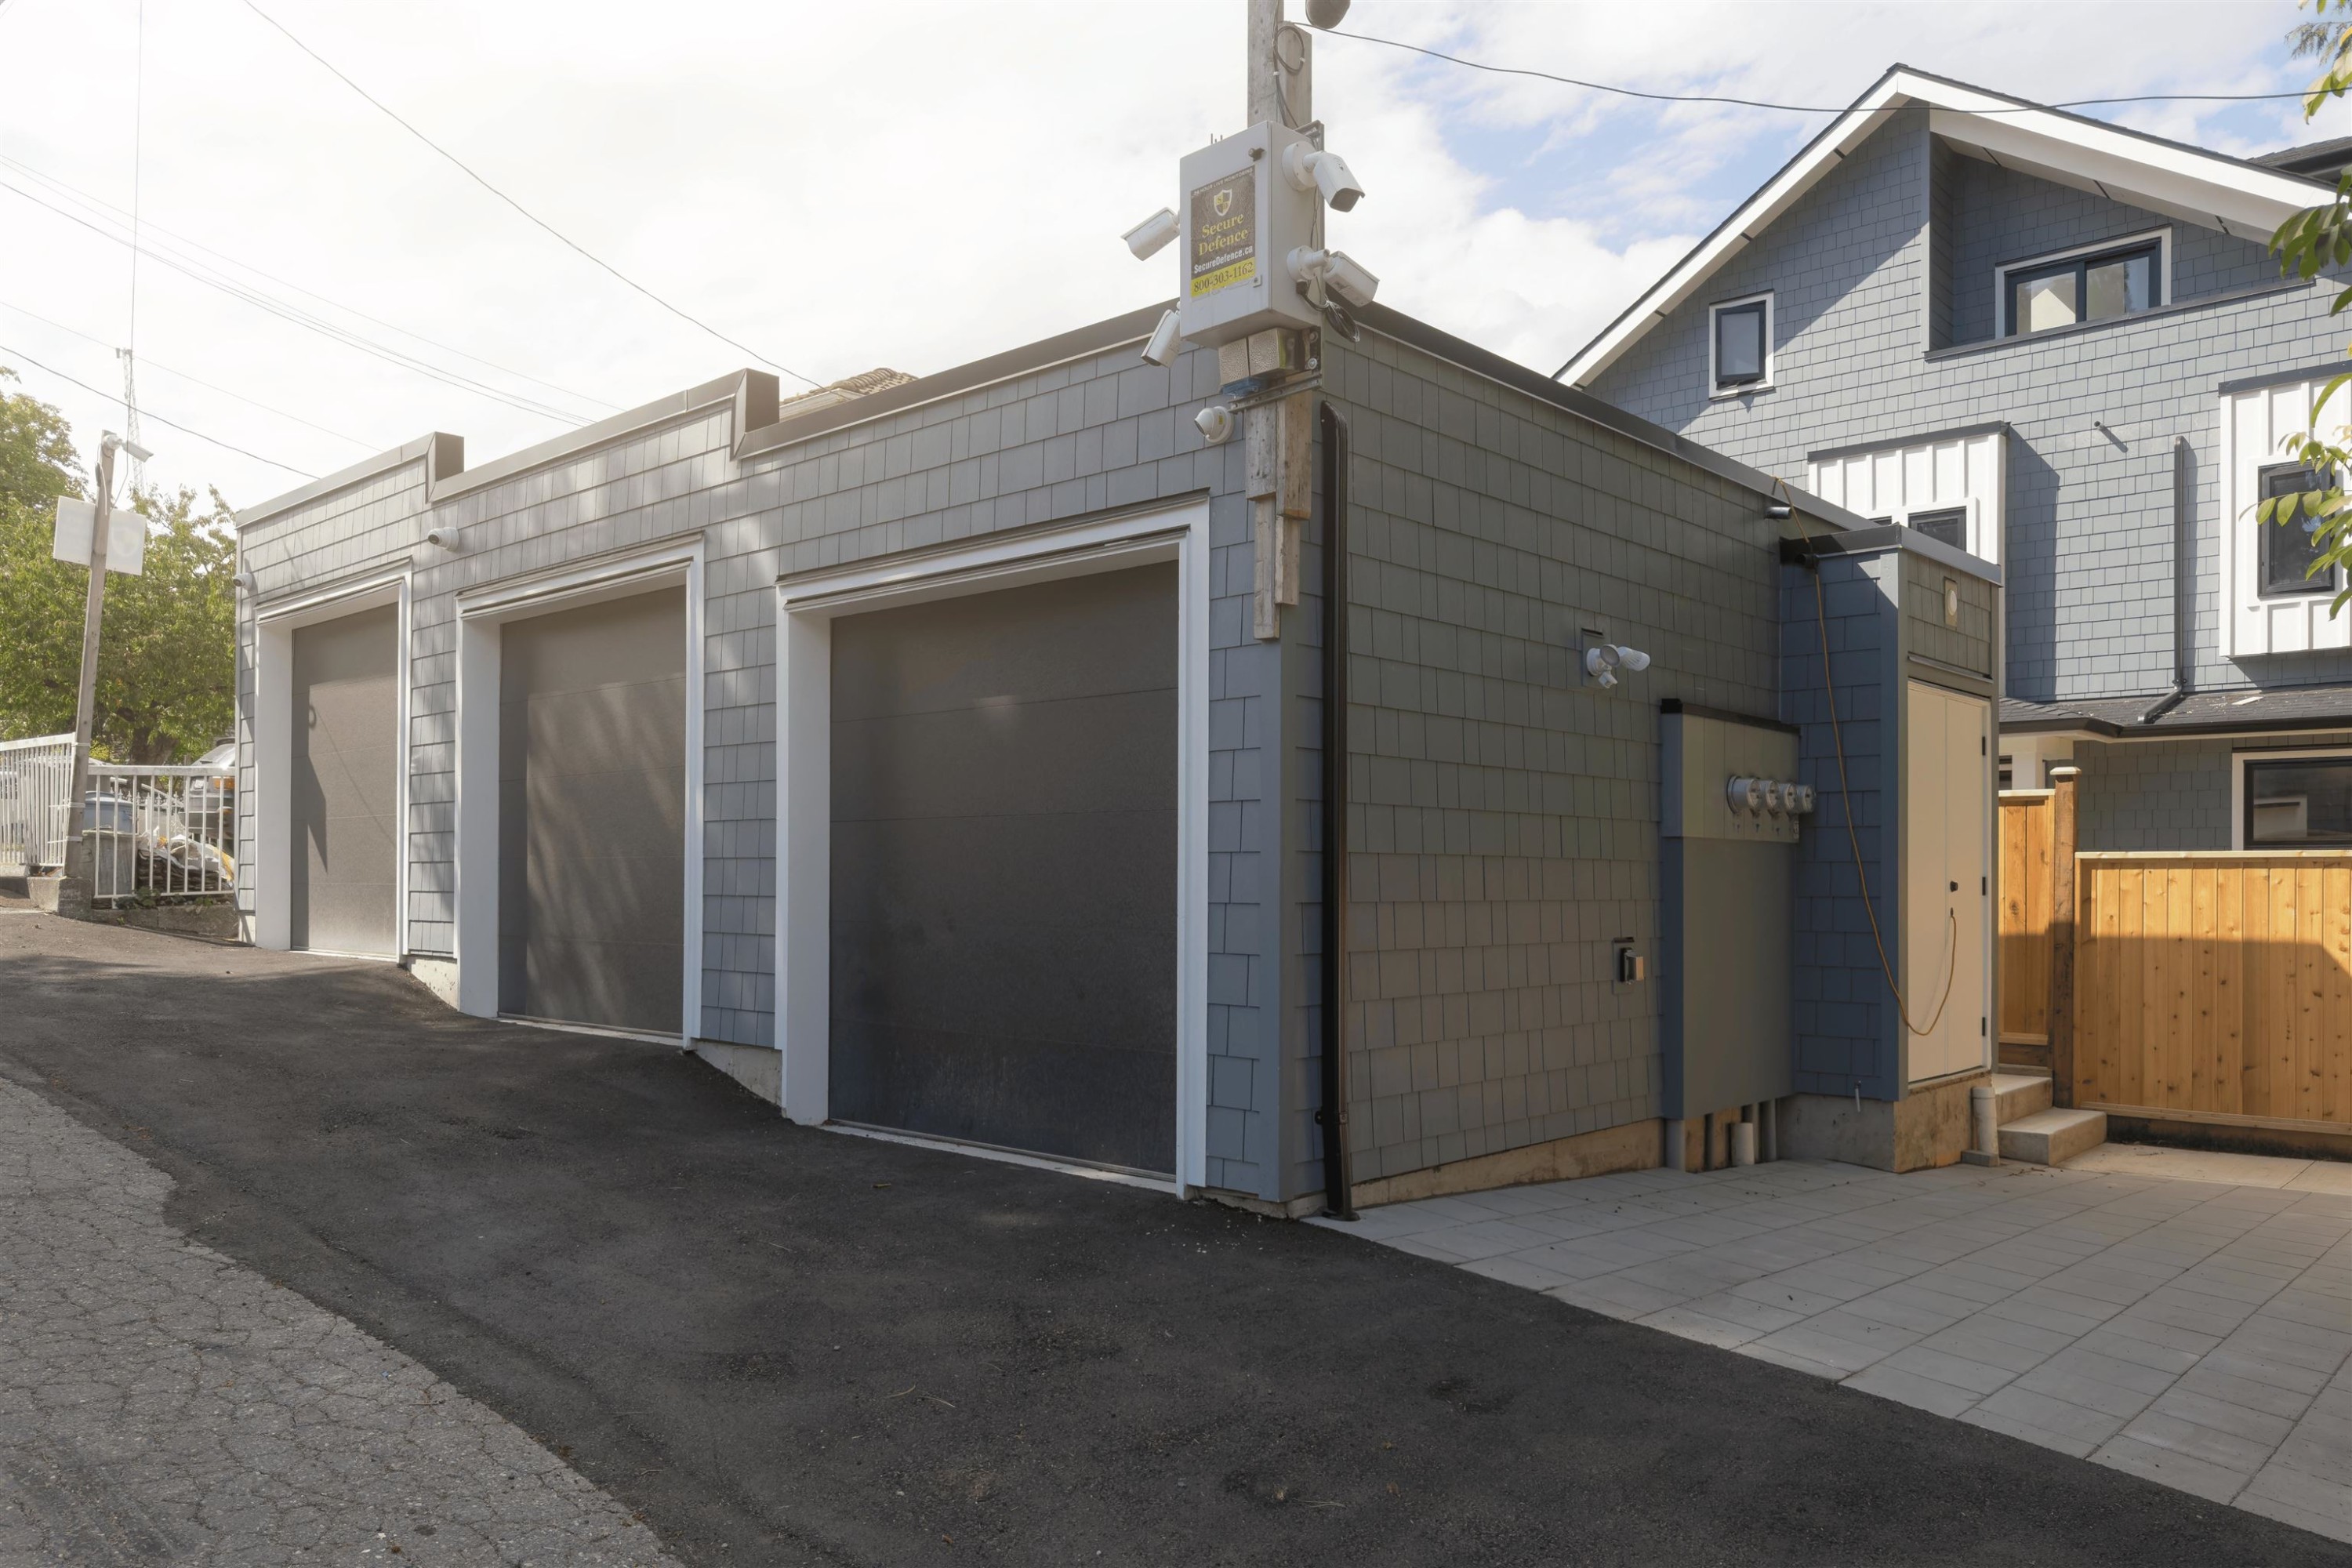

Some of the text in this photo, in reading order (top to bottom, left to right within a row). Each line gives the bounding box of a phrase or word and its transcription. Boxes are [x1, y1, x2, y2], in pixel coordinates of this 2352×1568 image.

[1224, 167, 1253, 182] MONITORING
[1202, 214, 1244, 238] Secure
[1199, 229, 1248, 256] Defence
[1194, 245, 1253, 274] SecureDefence.ca
[1194, 262, 1253, 292] 800-303-1162
